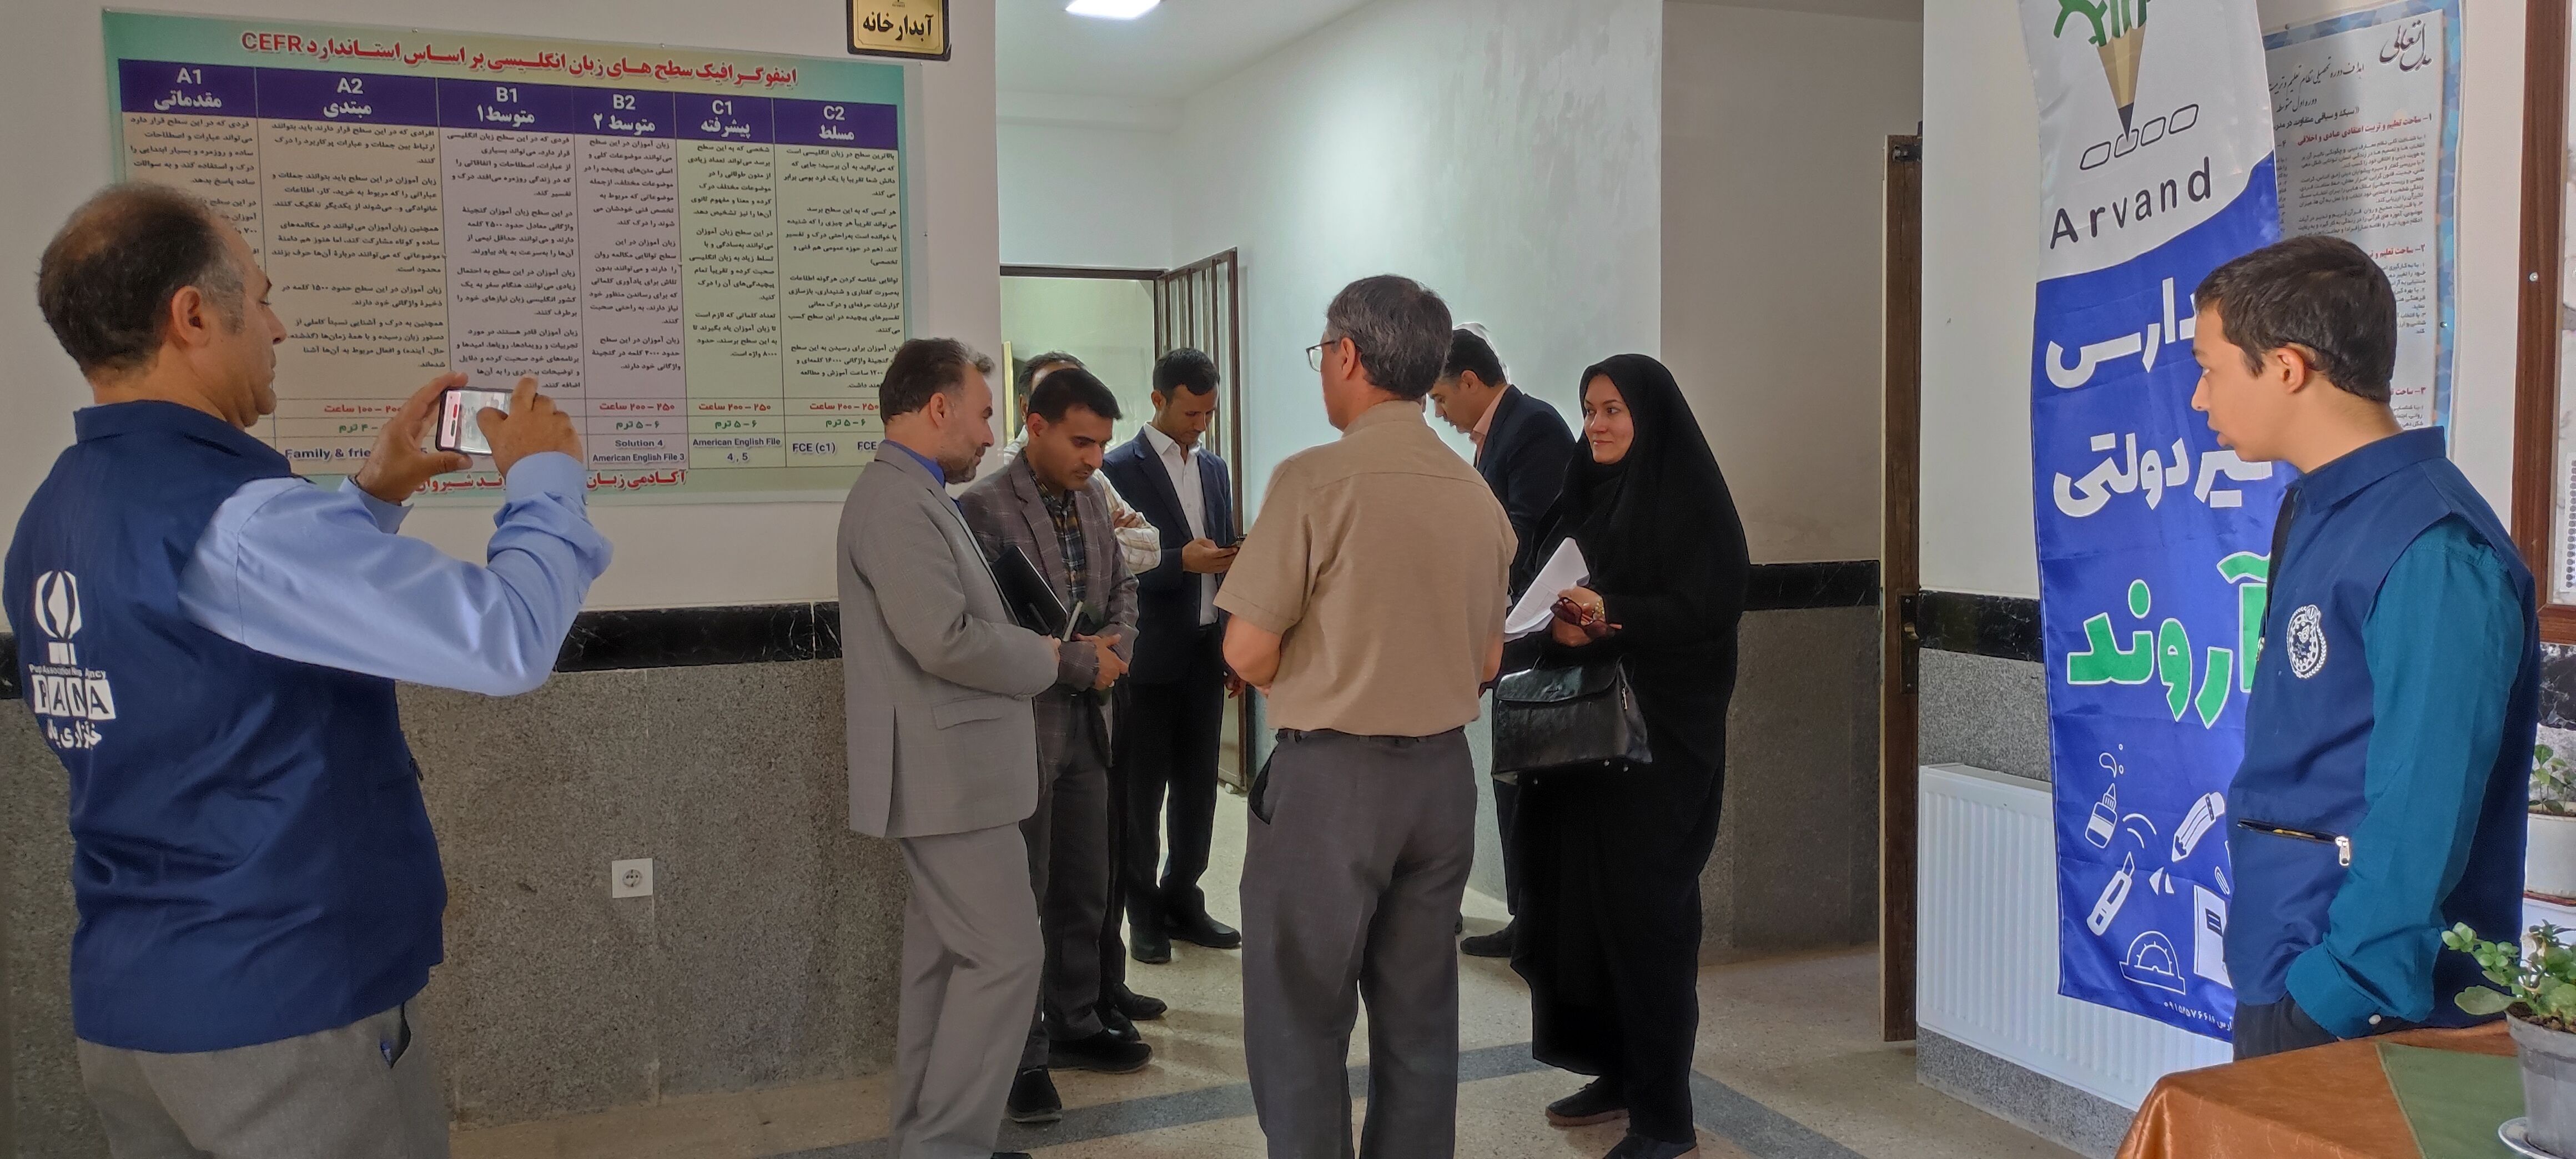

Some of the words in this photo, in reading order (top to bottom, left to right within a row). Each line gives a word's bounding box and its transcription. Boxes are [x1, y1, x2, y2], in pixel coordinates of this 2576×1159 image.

[863, 12, 933, 42] آبدارخانه
[242, 33, 301, 52] CEFR
[307, 38, 400, 59] استاندارد
[404, 44, 466, 65] اساس
[470, 53, 484, 68] بر
[488, 52, 565, 70] انگلیسی
[570, 55, 603, 76] زبان
[607, 58, 651, 77] های
[655, 60, 692, 80] سطح
[2313, 57, 2331, 84] تحصیلی
[2330, 68, 2343, 79] دوره
[2343, 62, 2364, 75] اهداف
[177, 68, 201, 84] A1
[696, 63, 796, 87] اینفوگرافیک
[338, 78, 364, 94] A2
[154, 90, 222, 110] مقدماتی
[496, 87, 517, 102] B1
[613, 94, 635, 110] B2
[2305, 98, 2317, 107] دوره
[324, 102, 371, 118] مبتدی
[712, 100, 732, 115] C1
[2292, 94, 2305, 112] اول
[824, 105, 844, 120] C2
[609, 115, 655, 135] متوسط
[701, 117, 751, 139] پیشرفته
[2293, 117, 2314, 127] متفاوت
[819, 125, 854, 140] مسلط
[2050, 156, 2211, 249] Arvand
[2379, 248, 2394, 258] تعلیم
[2394, 246, 2414, 255] ساحت
[2045, 277, 2196, 389] دارس
[2394, 387, 2414, 396] ساحت
[324, 404, 354, 412] ساعت
[339, 424, 358, 433] ترم
[616, 421, 633, 430] ترم
[715, 421, 731, 429] ترم
[826, 419, 841, 427] ترم
[734, 438, 763, 447] English
[793, 444, 812, 452] FCE
[816, 442, 835, 453] (c1)
[858, 442, 877, 450] FCE
[283, 449, 330, 462] Family
[335, 449, 344, 457] &
[349, 449, 371, 457] frie
[633, 453, 661, 464] English
[587, 472, 626, 490] زبان
[627, 469, 688, 490] آکادمی
[2053, 432, 2190, 518] دولتی
[2066, 551, 2269, 729] آروند
[37, 678, 110, 715] PANA
